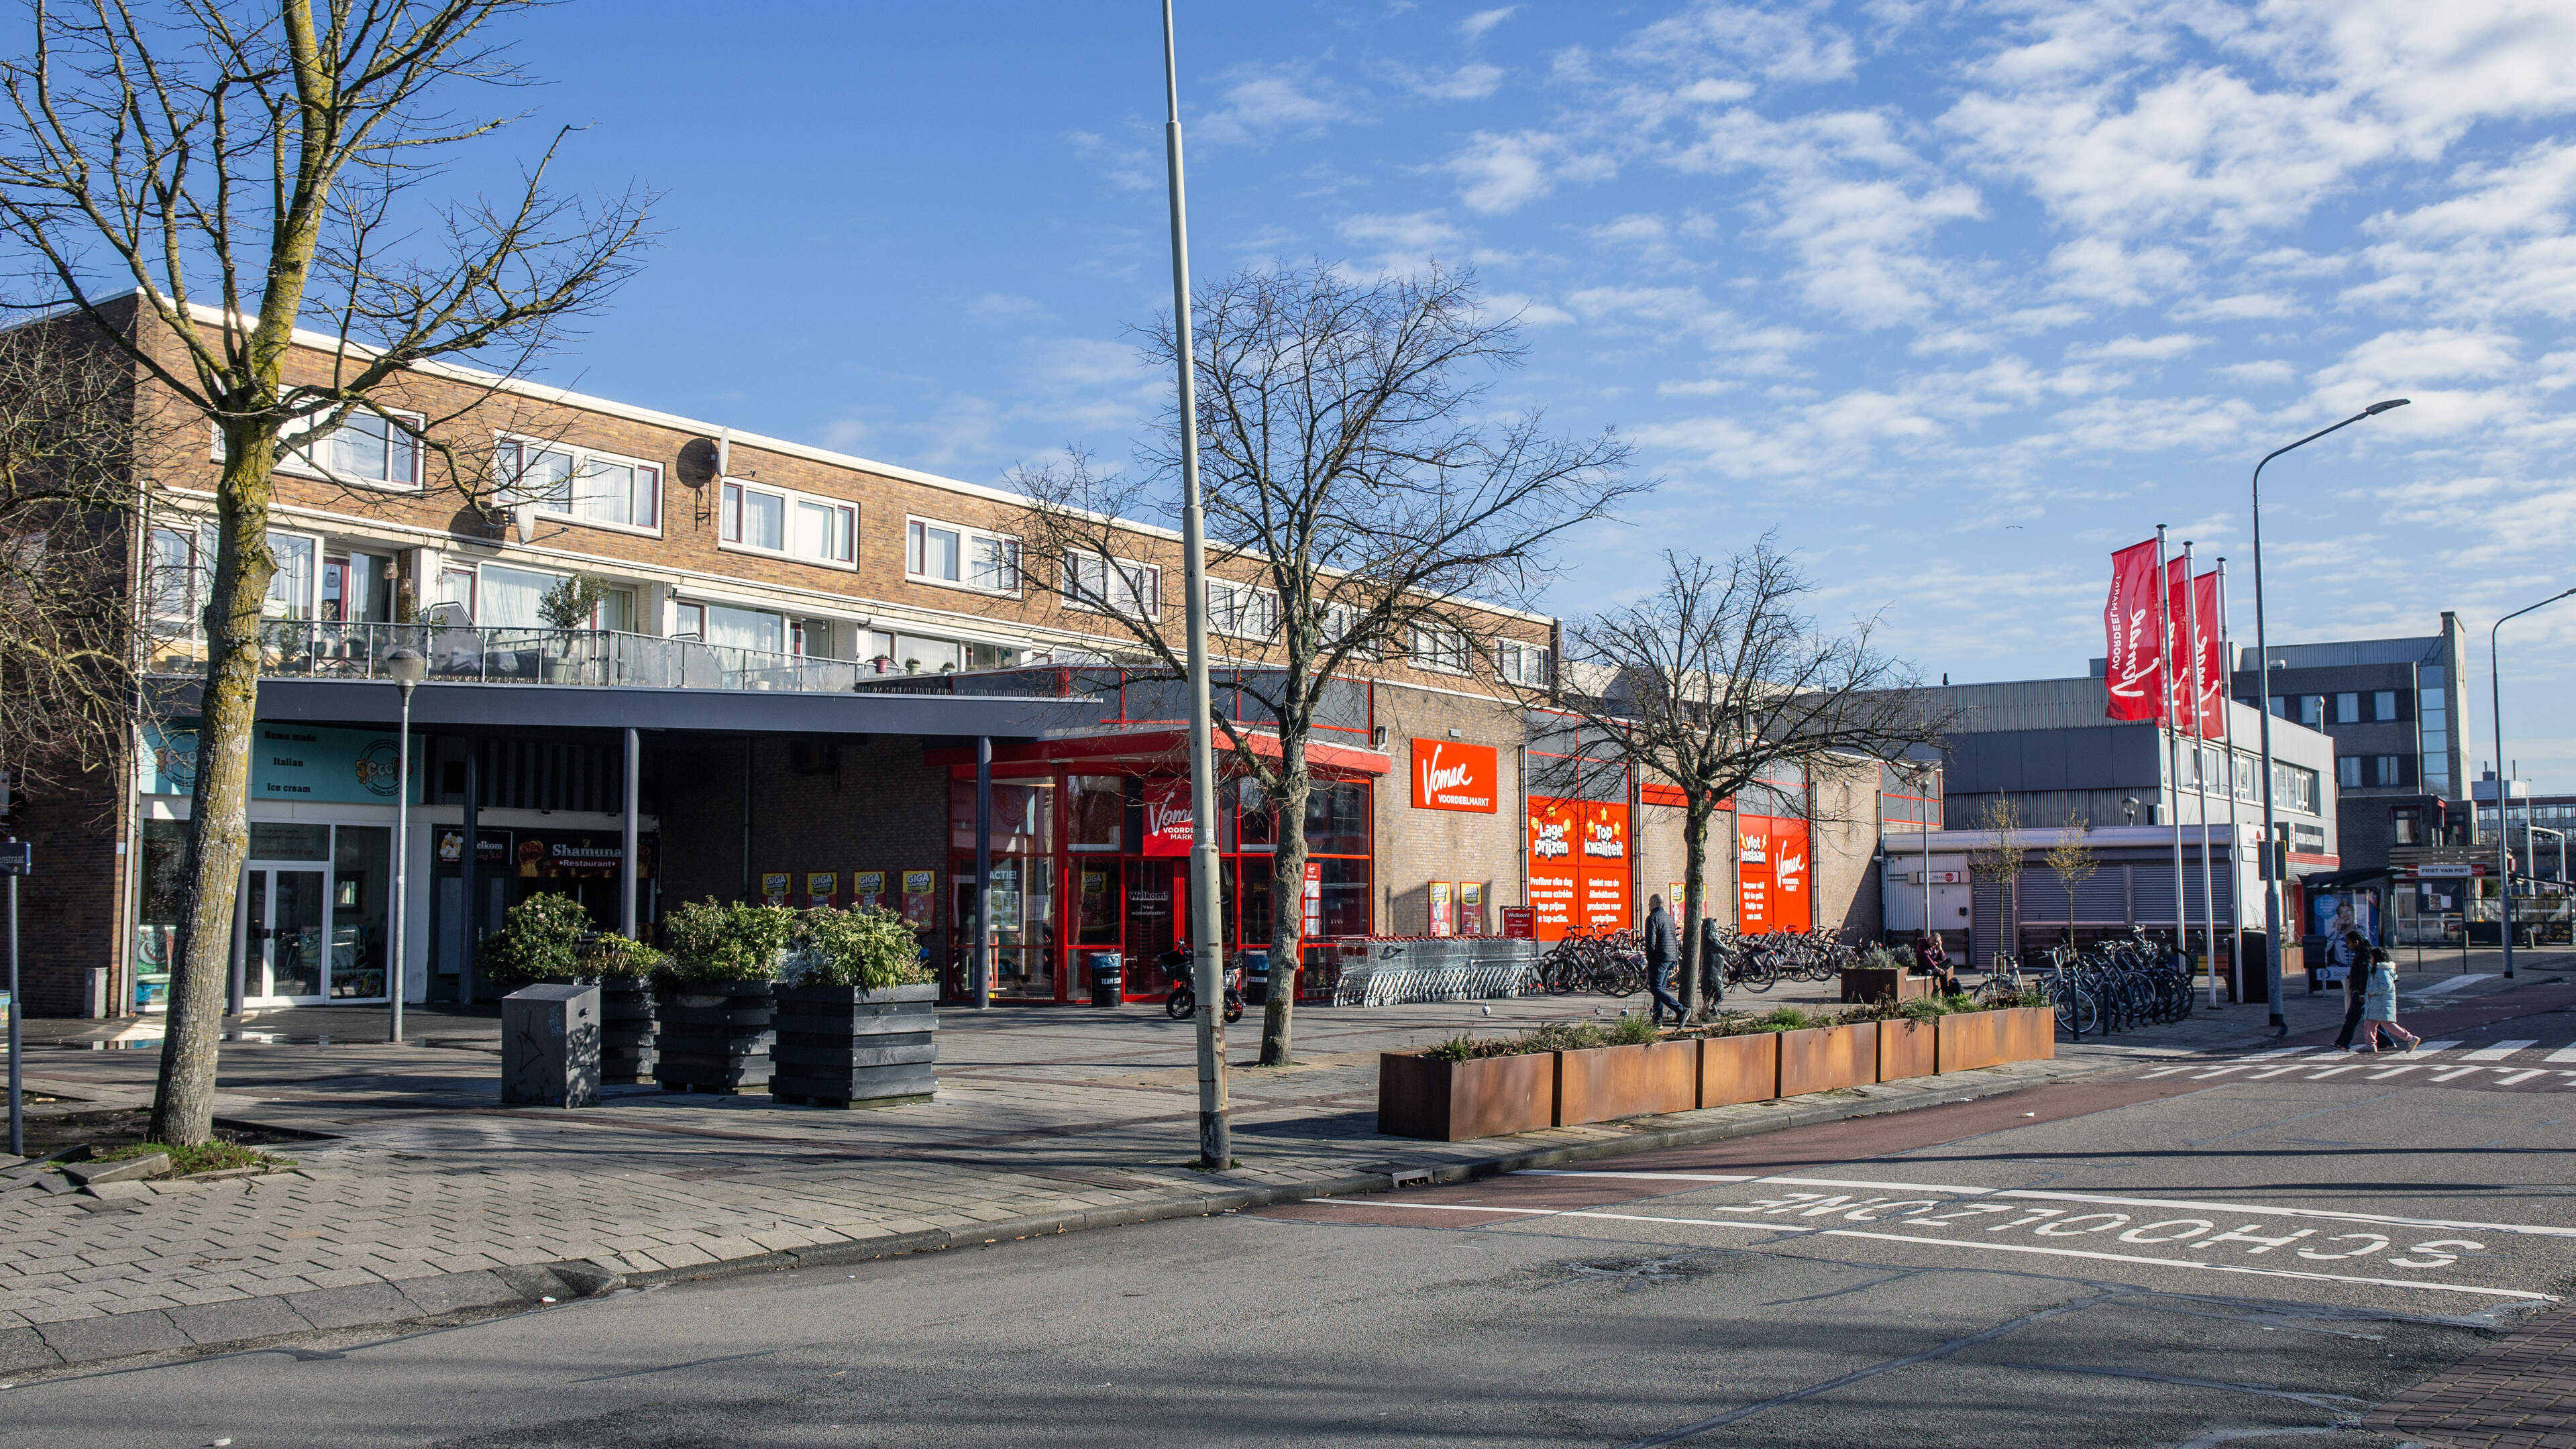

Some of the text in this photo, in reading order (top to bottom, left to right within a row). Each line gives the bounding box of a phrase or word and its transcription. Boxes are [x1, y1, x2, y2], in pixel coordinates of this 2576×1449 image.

[264, 730, 290, 741] Home
[274, 757, 303, 767] Italian
[1423, 743, 1472, 806] Vomar
[267, 783, 280, 792] Ice
[1438, 794, 1489, 806] VOORDEELMARKT
[1539, 822, 1564, 840] Lage
[1595, 824, 1612, 841] Top
[1585, 837, 1623, 857] kwaliteit
[1746, 835, 1761, 850] Vlot
[1535, 839, 1568, 859] prijzen
[1740, 848, 1766, 862] inslaan
[1776, 840, 1805, 888] Vomar
[766, 874, 786, 884] GIGA
[812, 874, 833, 884] GIGA
[859, 873, 881, 883] GIGA
[907, 872, 930, 883] GIGA
[1530, 877, 1572, 888] Profiteer elke dag
[1589, 878, 1604, 887] Geniet
[1613, 879, 1619, 887] de
[1129, 892, 1169, 900] Welkom!
[1538, 902, 1566, 912] lage prijzen
[1587, 902, 1611, 912] producten
[1713, 1193, 2485, 1267] SCHOOLZONE
